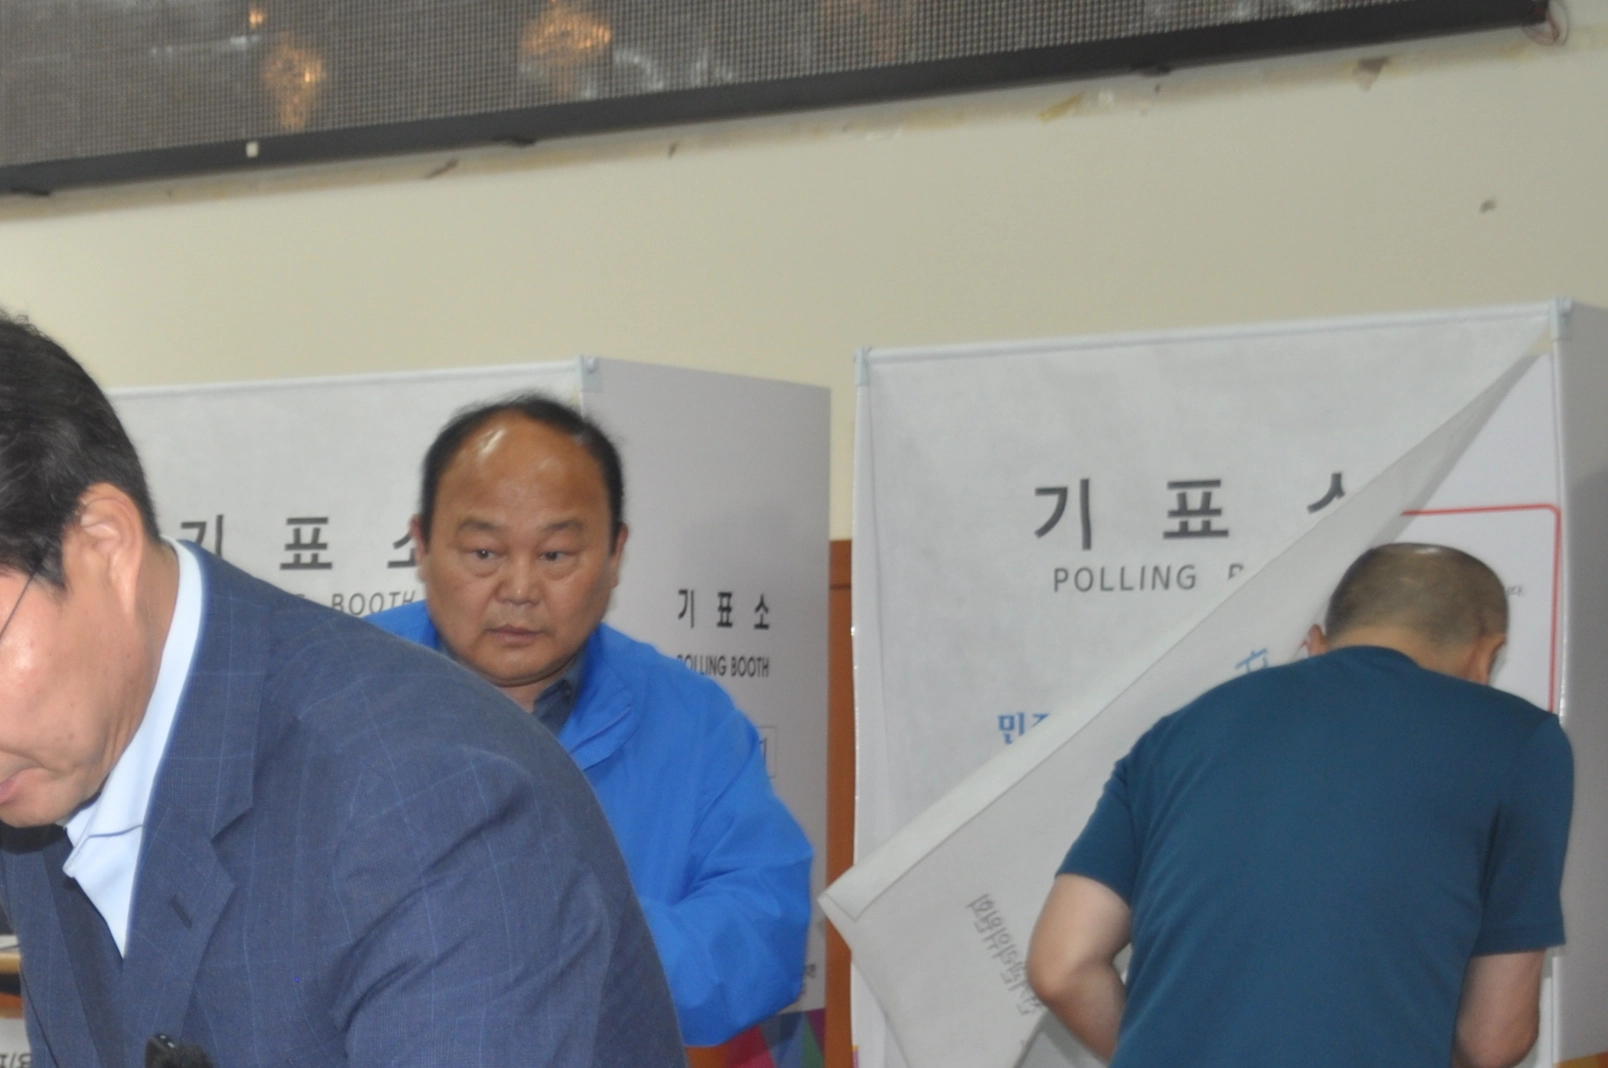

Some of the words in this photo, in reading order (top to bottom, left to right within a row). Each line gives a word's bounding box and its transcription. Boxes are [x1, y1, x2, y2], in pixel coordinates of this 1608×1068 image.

[1053, 564, 1197, 593] POLLING
[678, 589, 769, 630] 기표소
[731, 656, 770, 678] BOOTH
